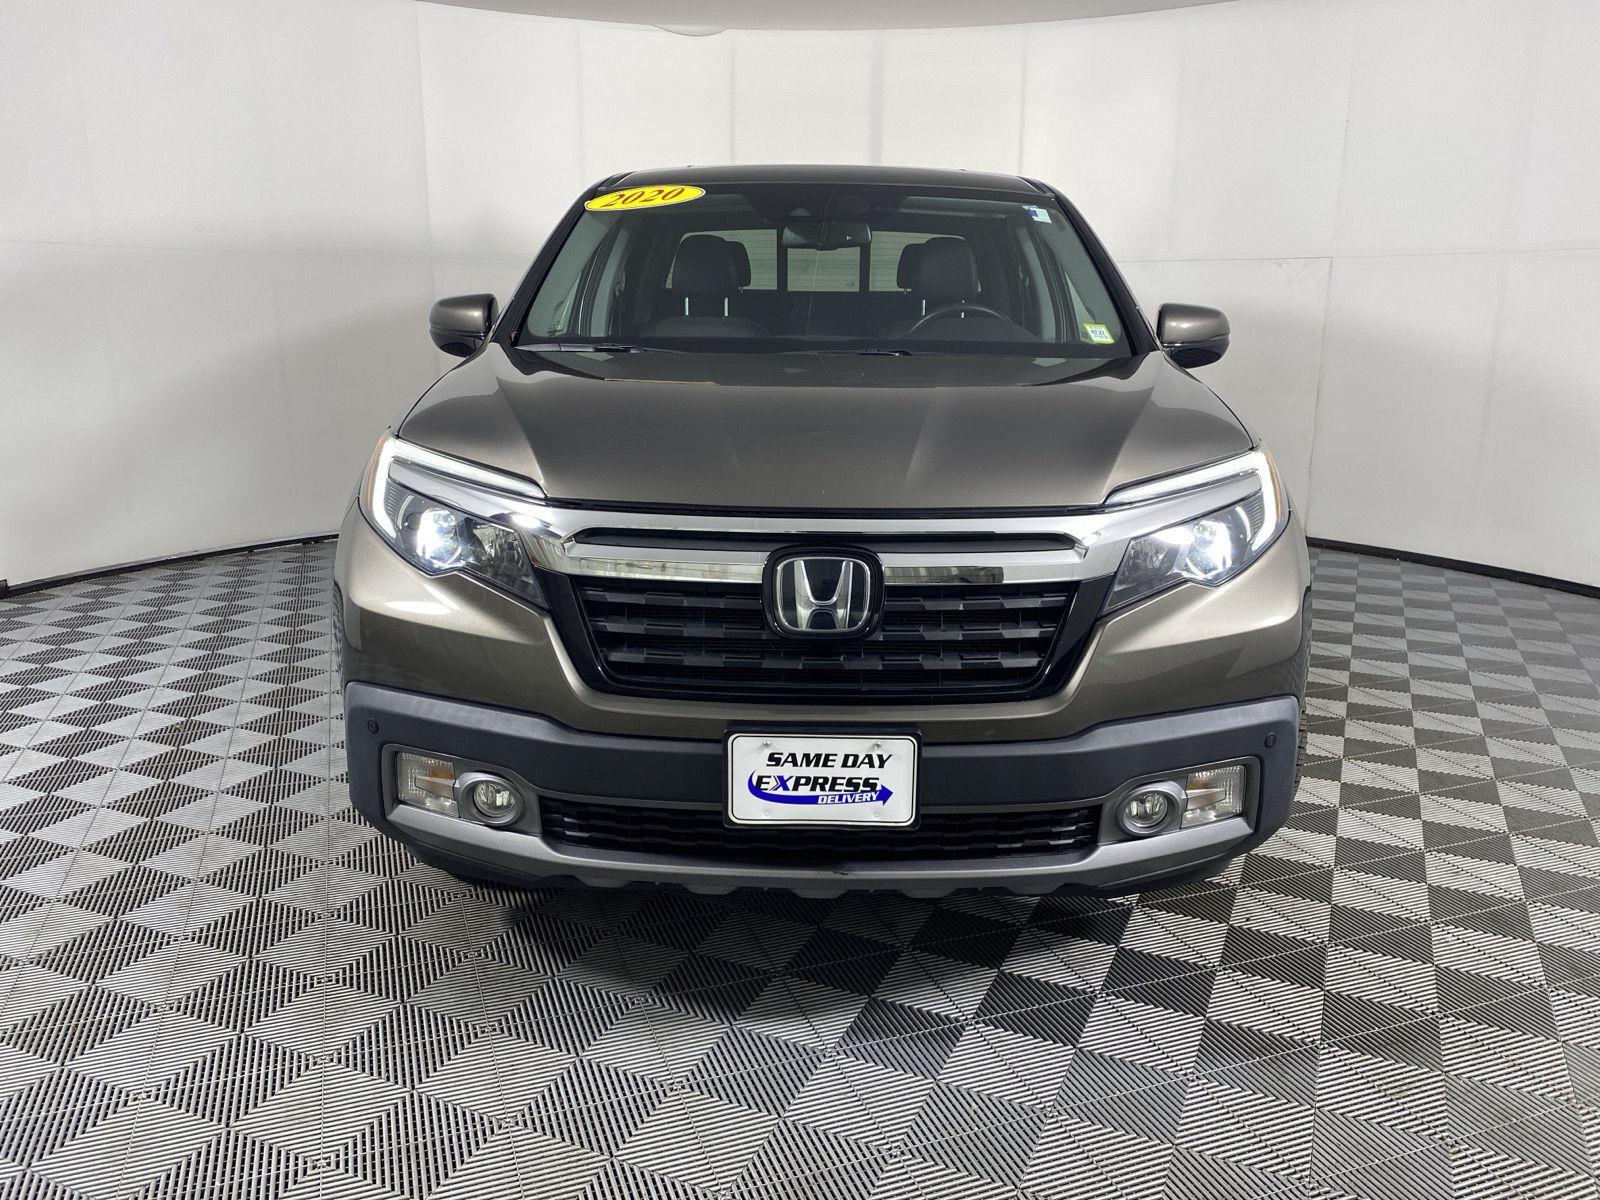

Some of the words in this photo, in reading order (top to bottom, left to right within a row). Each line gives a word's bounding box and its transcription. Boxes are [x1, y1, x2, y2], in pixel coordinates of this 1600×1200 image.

[600, 187, 685, 208] 2020
[766, 752, 837, 768] SAME
[840, 753, 893, 769] DAY
[755, 775, 880, 792] EXPRESS
[817, 791, 880, 804] DELIVERY
